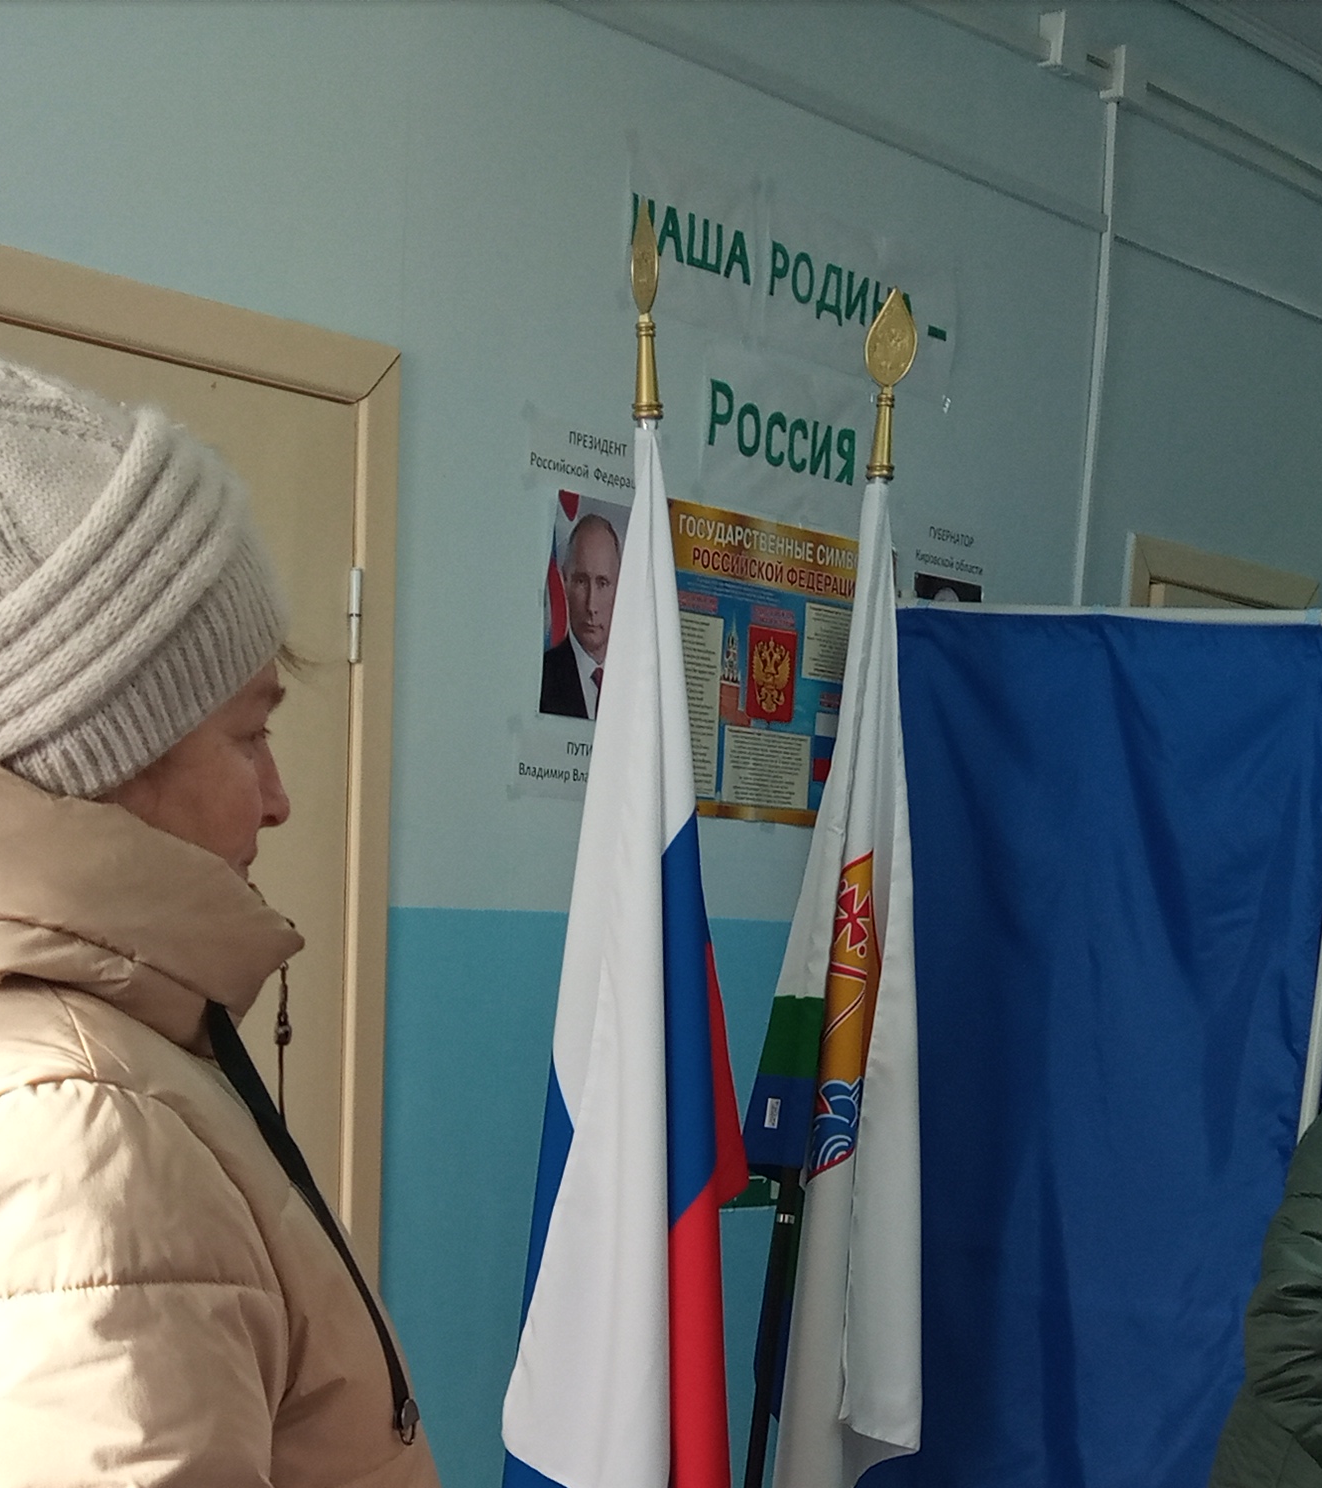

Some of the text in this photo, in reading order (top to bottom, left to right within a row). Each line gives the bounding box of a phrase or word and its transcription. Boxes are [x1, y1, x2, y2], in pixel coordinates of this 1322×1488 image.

[569, 431, 627, 456] ПРЕЗИДЕНТ
[708, 378, 856, 485] РОССИЯ
[530, 452, 589, 479] Российской
[679, 514, 813, 562] ГОСУДАРСТВЕННЫЕ
[929, 526, 974, 547] ГУБЕРНАТОР
[693, 547, 783, 583] РОССИЙСКОЙ
[916, 549, 954, 568] Кировской
[519, 763, 570, 784] Владимир
